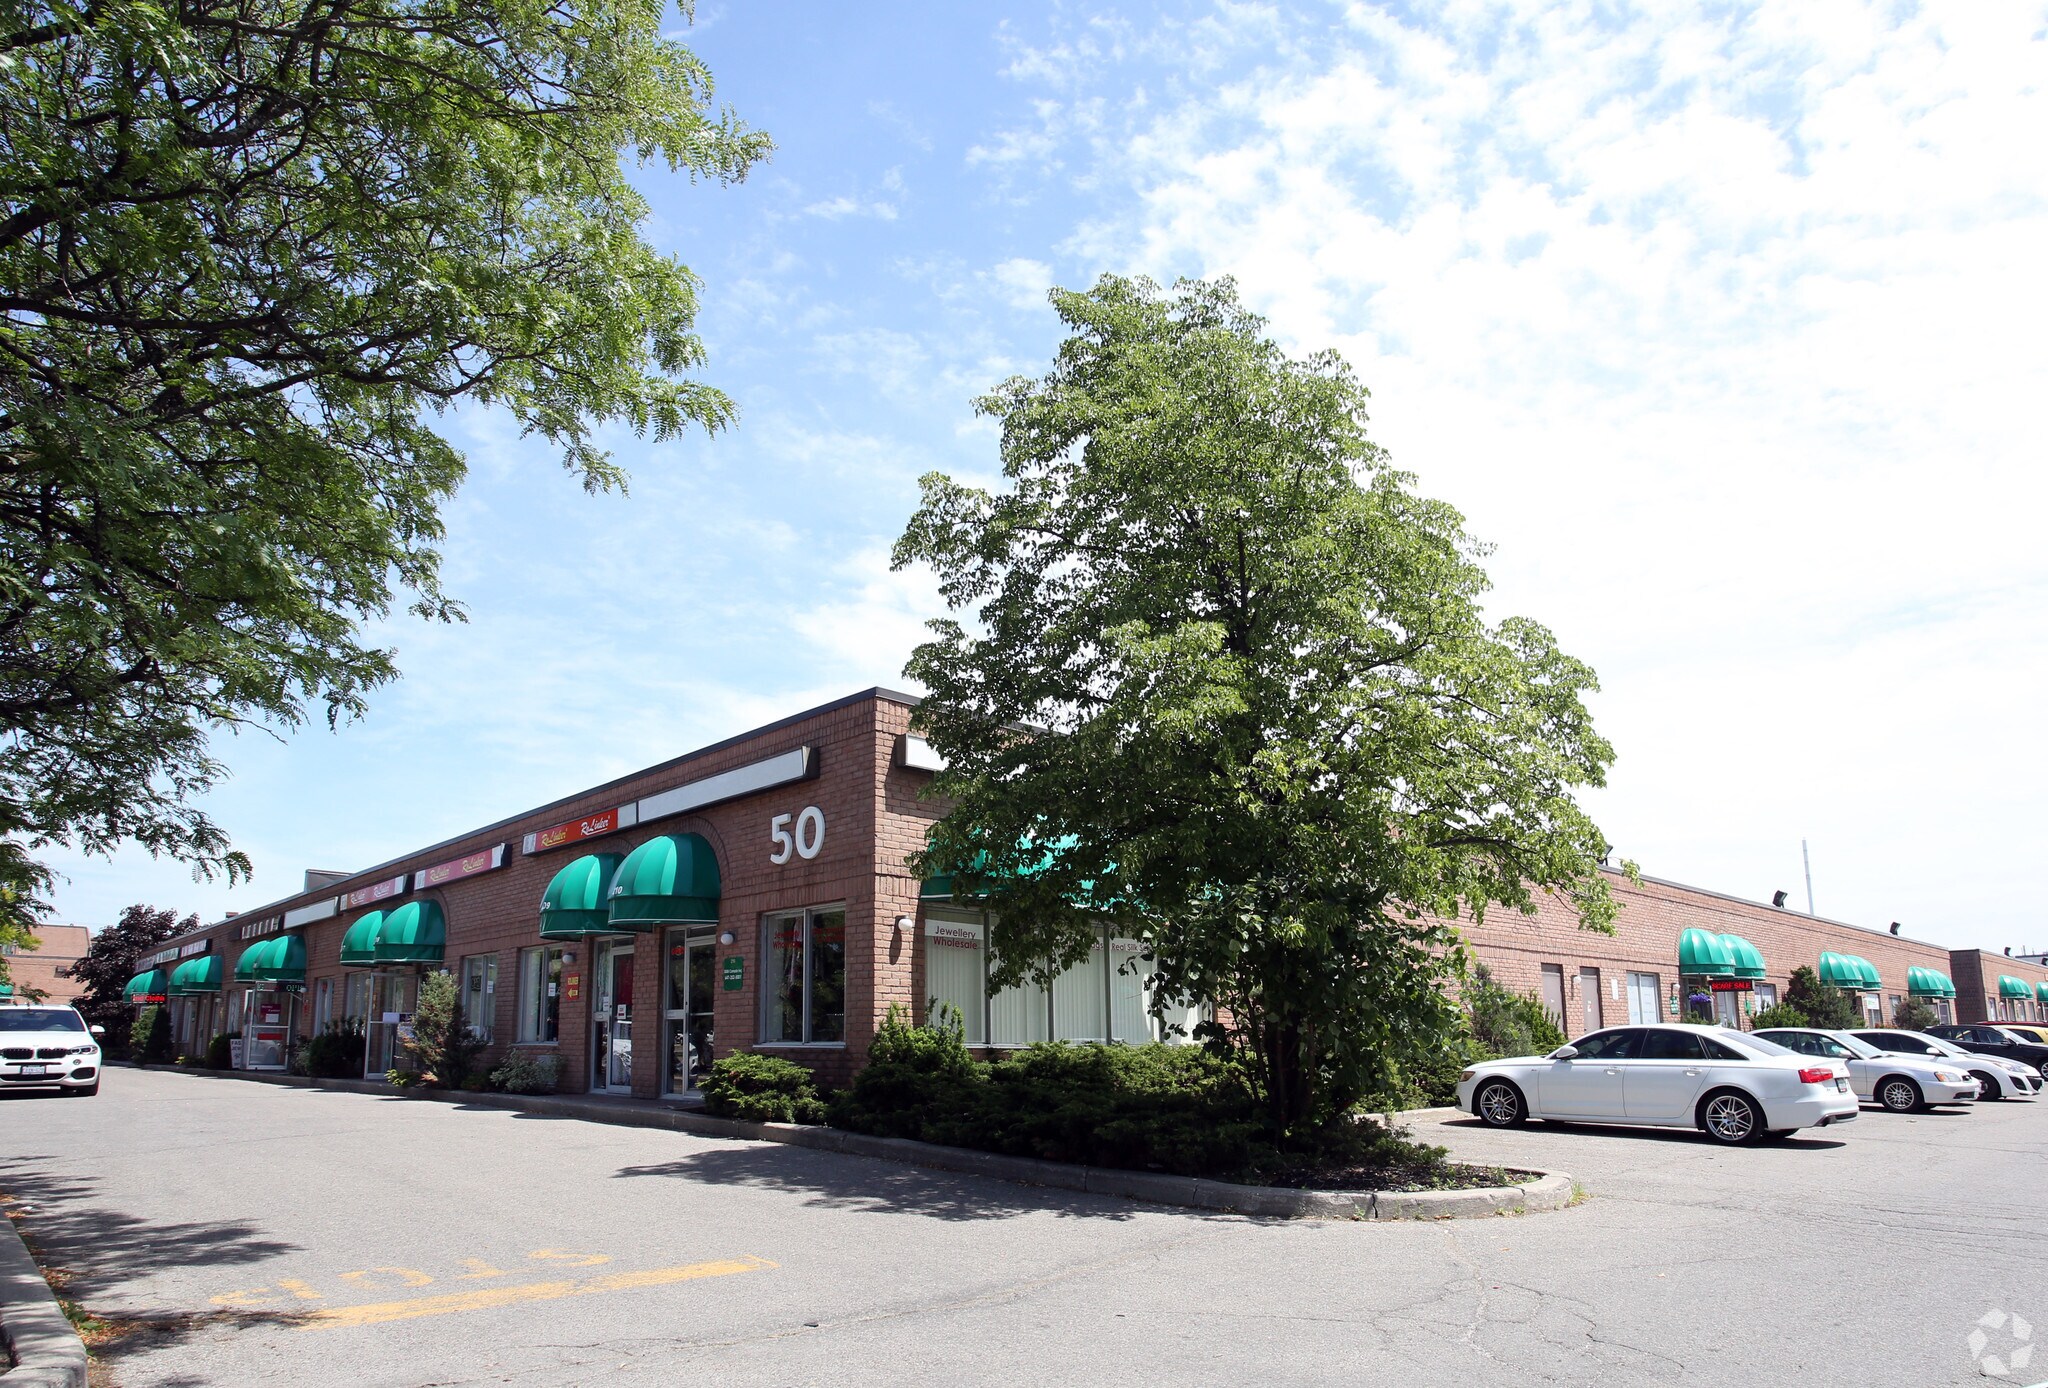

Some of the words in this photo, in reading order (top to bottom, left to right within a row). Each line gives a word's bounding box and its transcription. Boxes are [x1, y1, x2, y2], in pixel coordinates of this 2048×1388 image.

[770, 806, 826, 865] 50
[935, 925, 976, 940] Jewellery
[933, 936, 978, 950] Wholesale
[1111, 943, 1126, 951] Real
[1127, 943, 1138, 951] Silk
[1711, 982, 1733, 990] SCARF
